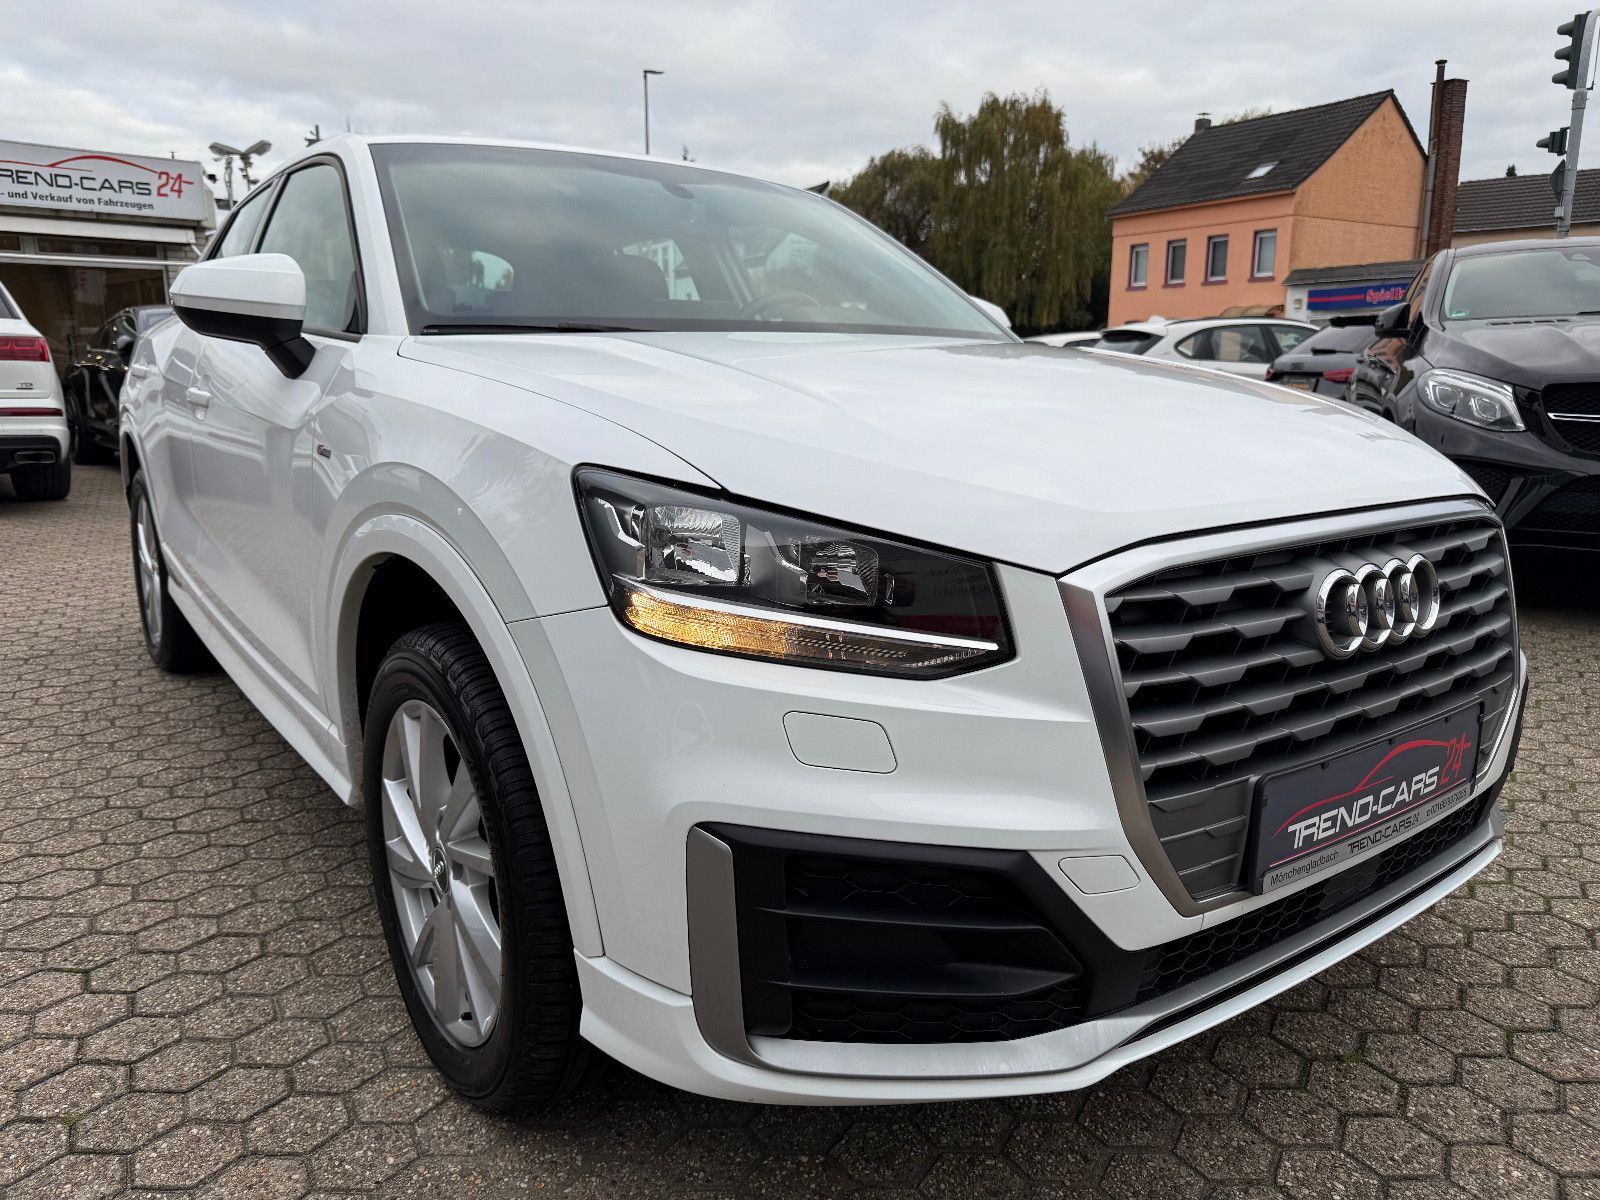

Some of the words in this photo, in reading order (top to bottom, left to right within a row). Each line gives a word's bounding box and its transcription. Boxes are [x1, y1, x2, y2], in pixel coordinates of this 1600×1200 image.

[8, 190, 29, 200] und
[31, 191, 73, 204] Verkauf
[77, 197, 95, 206] von
[97, 197, 154, 210] Fahrzeugen
[156, 171, 183, 198] 24
[1287, 766, 1440, 850] TREND-CARS
[1270, 850, 1339, 886] Mönchengladbach
